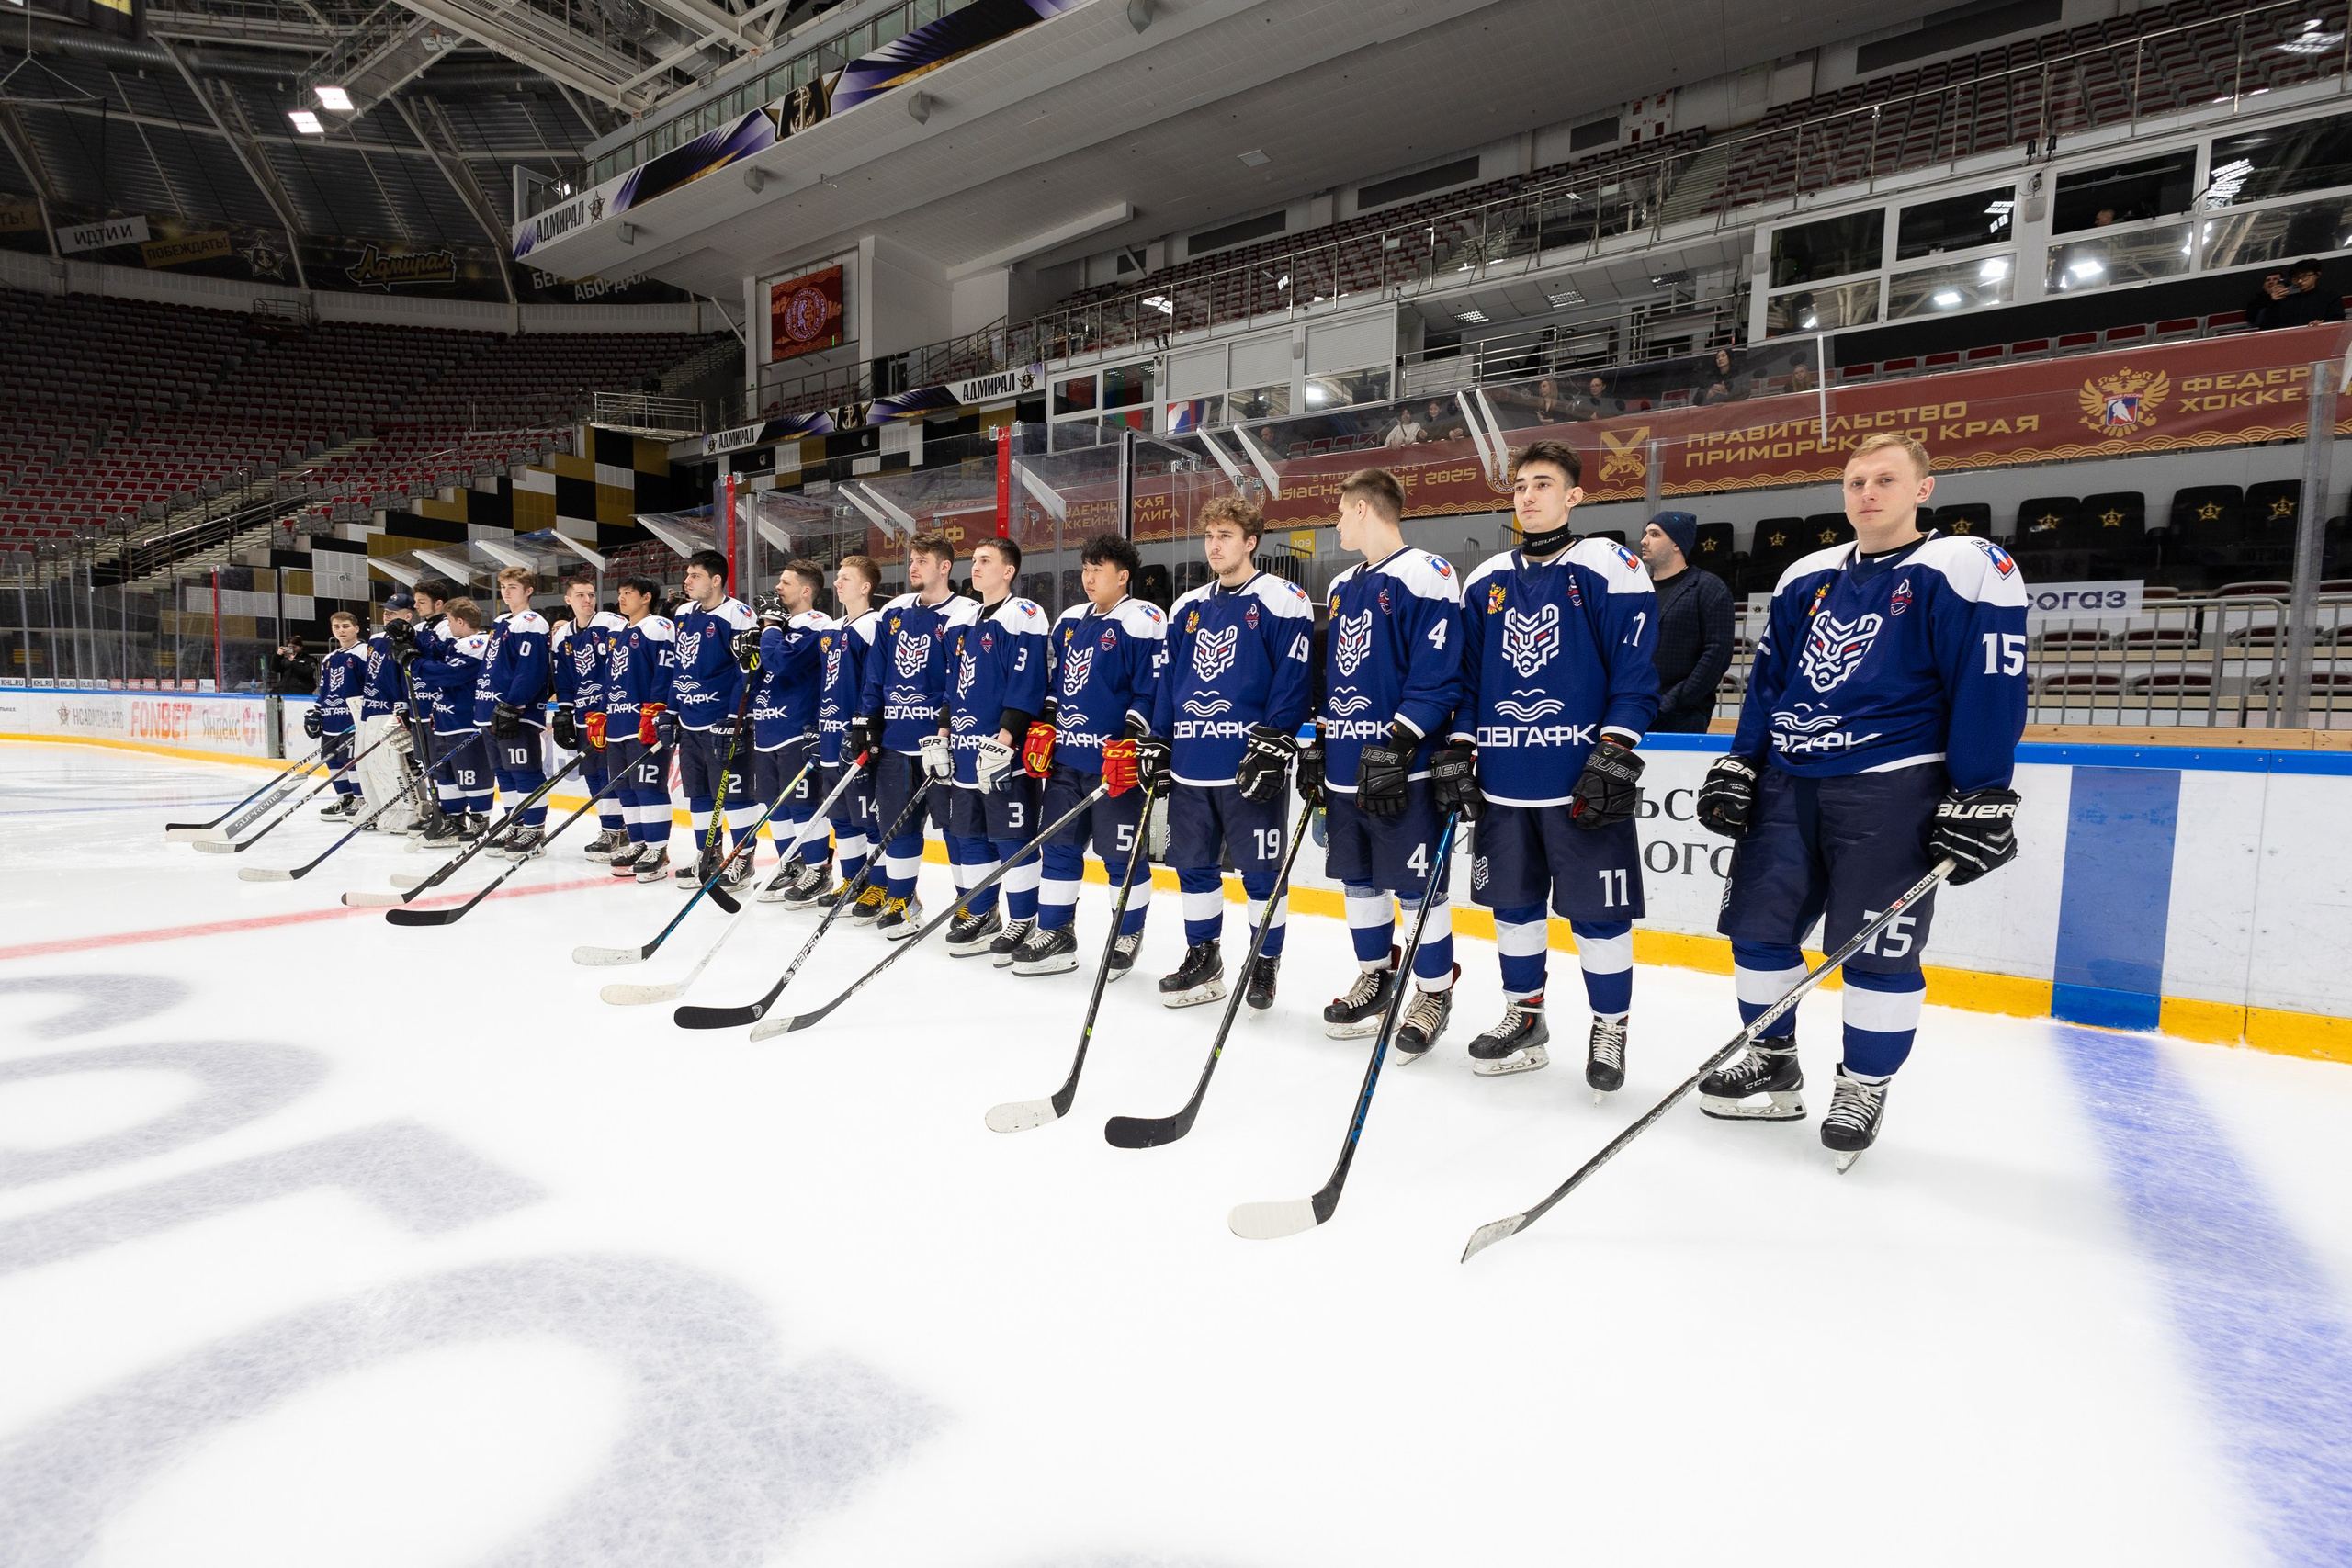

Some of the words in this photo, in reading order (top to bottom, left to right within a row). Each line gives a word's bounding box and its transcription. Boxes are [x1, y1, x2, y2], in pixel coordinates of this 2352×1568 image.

[74, 226, 119, 246] ИДТИ
[121, 224, 133, 237] И
[536, 200, 585, 244] АДМИРАЛ
[147, 236, 228, 261] ПОБЕЖДАТЬ!
[963, 372, 1016, 402] АДМИРАЛ
[2181, 366, 2313, 392] ФЕДЕР
[2177, 386, 2304, 413] ХОККЕ
[1687, 400, 1968, 449] ПРАВИТЕЛЬСТВО
[1939, 414, 2040, 442] КРАЯ
[718, 427, 755, 449] АДМИРАЛ
[1424, 467, 1477, 486] 2025
[1139, 508, 1181, 522] ЛИГА
[1294, 539, 1312, 548] 109
[1428, 618, 1448, 650] 4
[658, 649, 675, 668] 12
[1014, 647, 1027, 671] 3
[1982, 632, 2026, 677] 15
[131, 701, 192, 741] FONBET
[1325, 719, 1396, 740] ВГАФК
[1477, 723, 1597, 748] ДВГАФК
[508, 748, 528, 764] 10
[1248, 737, 1296, 761] CCM
[458, 770, 476, 786] 18
[638, 764, 660, 784] 12
[1713, 758, 1757, 782] UER
[406, 772, 420, 806] VAUHN
[729, 773, 741, 794] 2
[796, 779, 809, 799] 9
[234, 791, 282, 830] SUPREME
[282, 792, 315, 820] CCM
[706, 769, 730, 848] SHERWOOD
[1008, 802, 1024, 828] 3
[1935, 803, 2017, 818] AUER
[451, 829, 490, 865] CCM
[1116, 824, 1135, 851] 5
[1253, 829, 1281, 860] 19
[501, 842, 542, 881] CCM
[1406, 842, 1429, 878] 4
[1599, 869, 1629, 907] 11
[1862, 909, 1917, 958] 15
[1347, 1040, 1389, 1146] NEXUS
[1744, 1075, 1772, 1090] CCM
